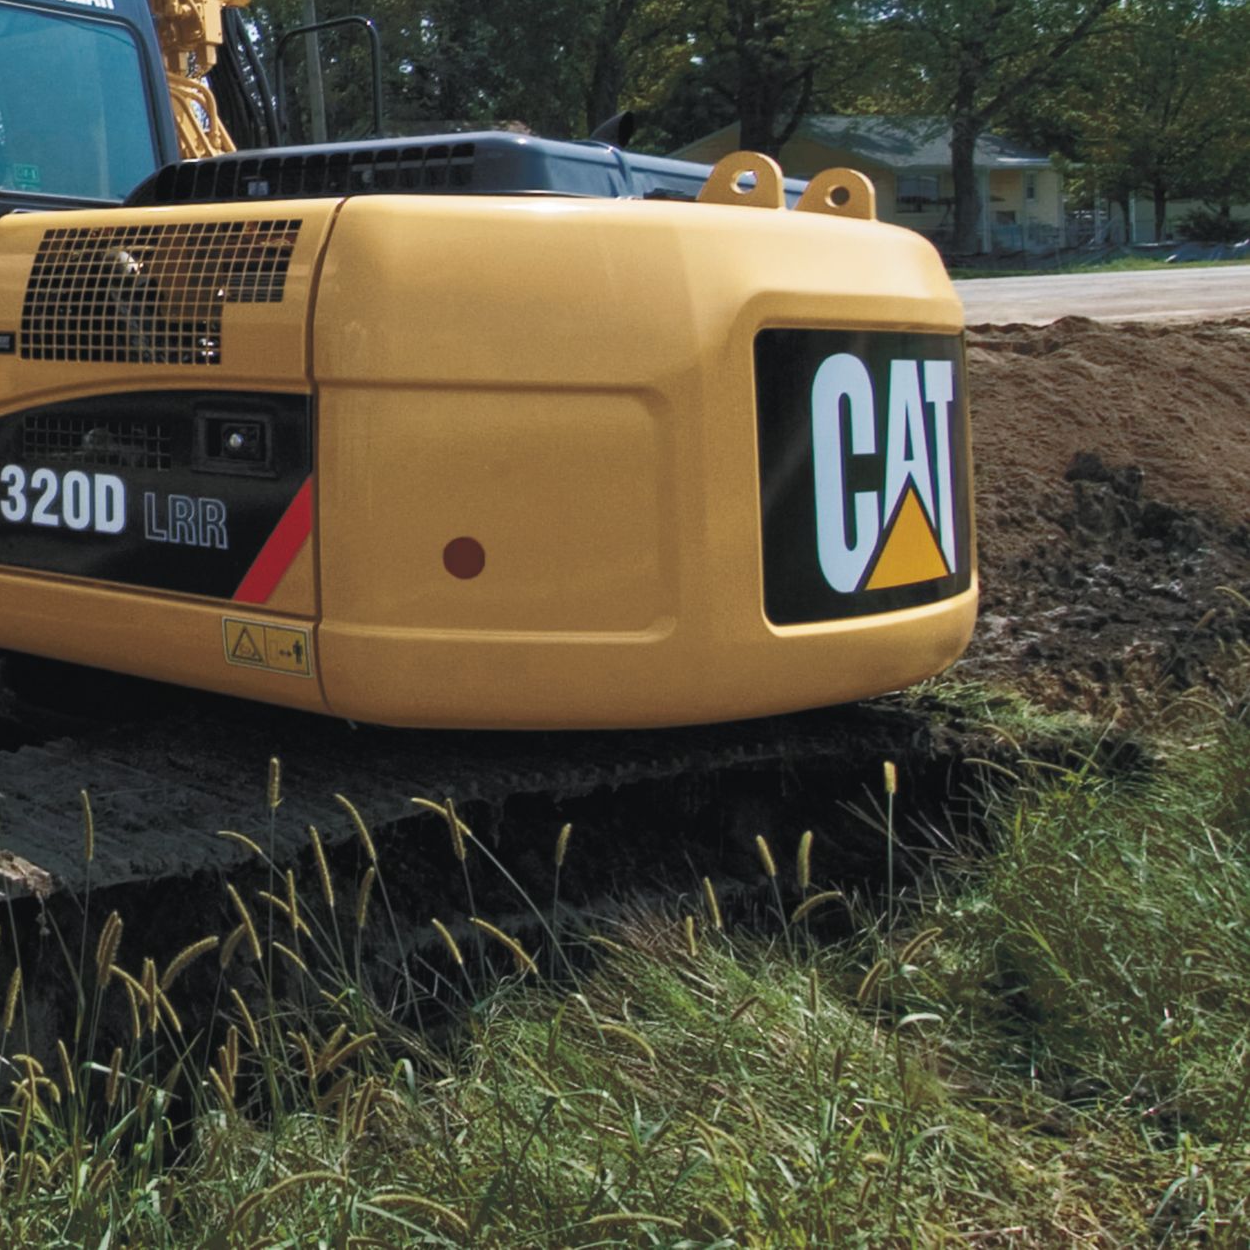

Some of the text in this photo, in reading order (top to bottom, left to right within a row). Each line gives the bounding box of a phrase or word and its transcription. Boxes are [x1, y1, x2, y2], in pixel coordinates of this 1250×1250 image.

[0, 464, 228, 549] 320D LRR
[811, 353, 956, 593] CAT
